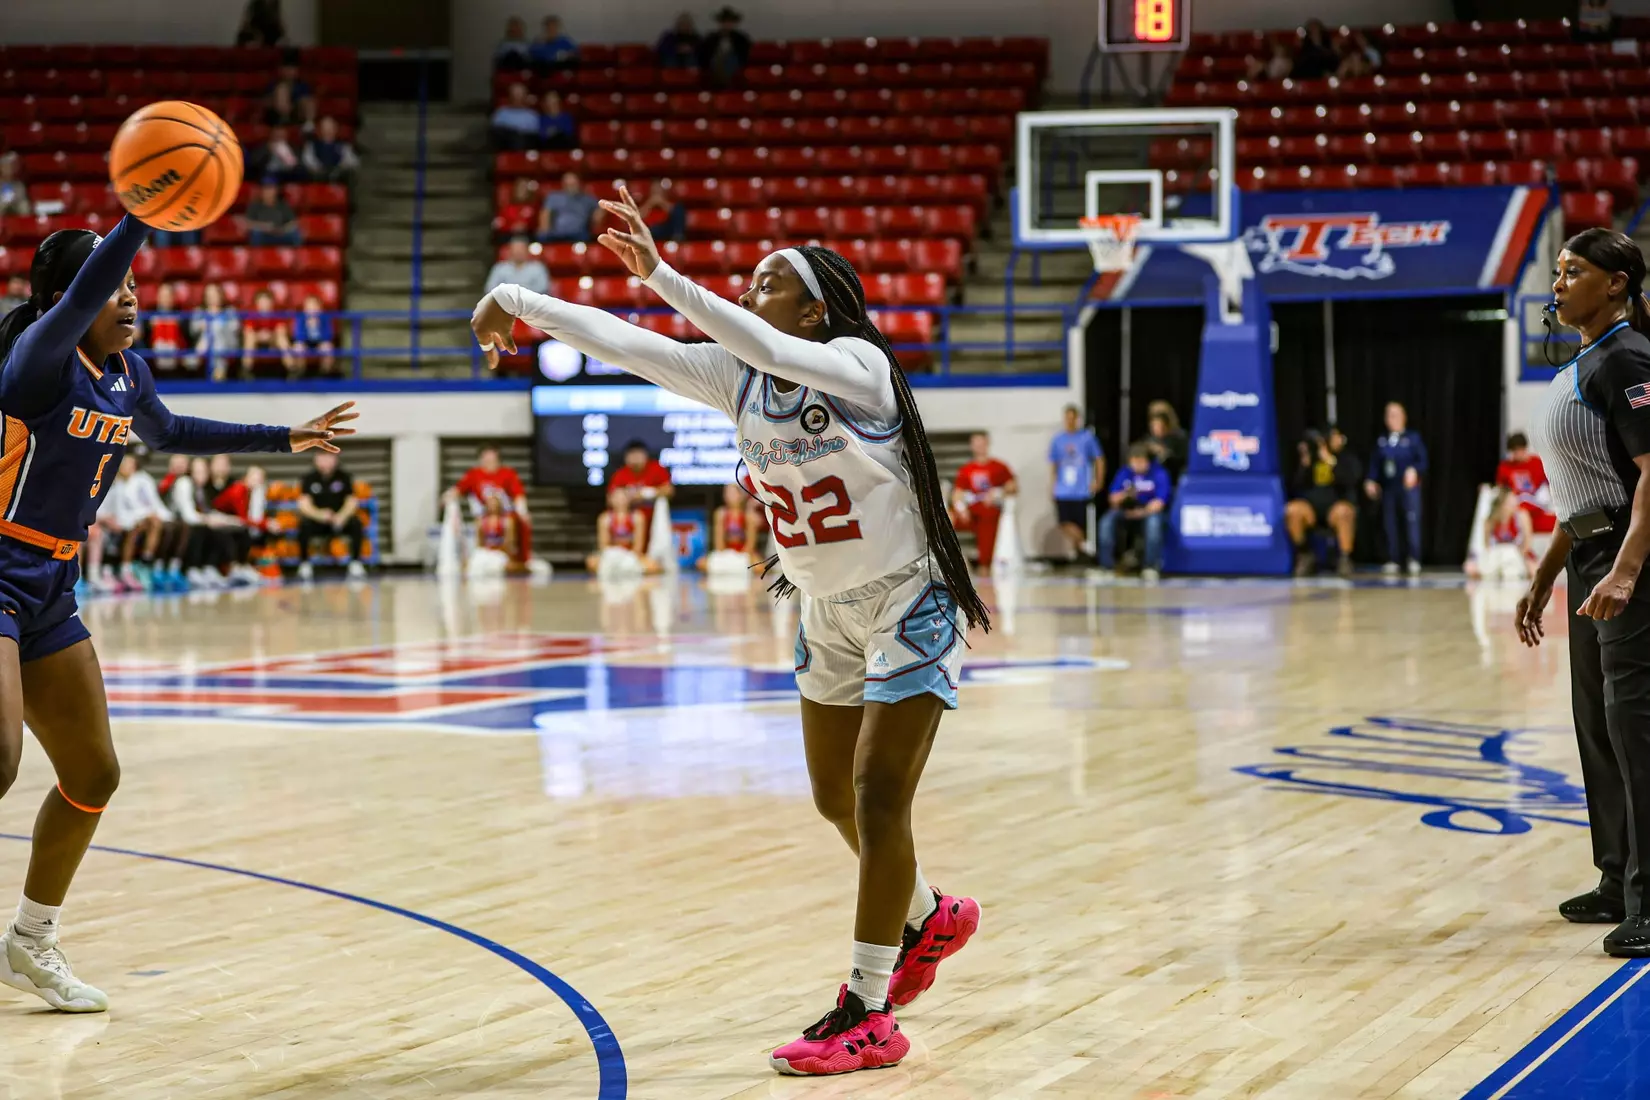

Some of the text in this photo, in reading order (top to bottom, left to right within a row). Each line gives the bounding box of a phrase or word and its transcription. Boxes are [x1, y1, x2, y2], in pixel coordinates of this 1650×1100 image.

[1134, 0, 1173, 41] 18
[90, 454, 114, 498] 5
[760, 474, 863, 549] 22
